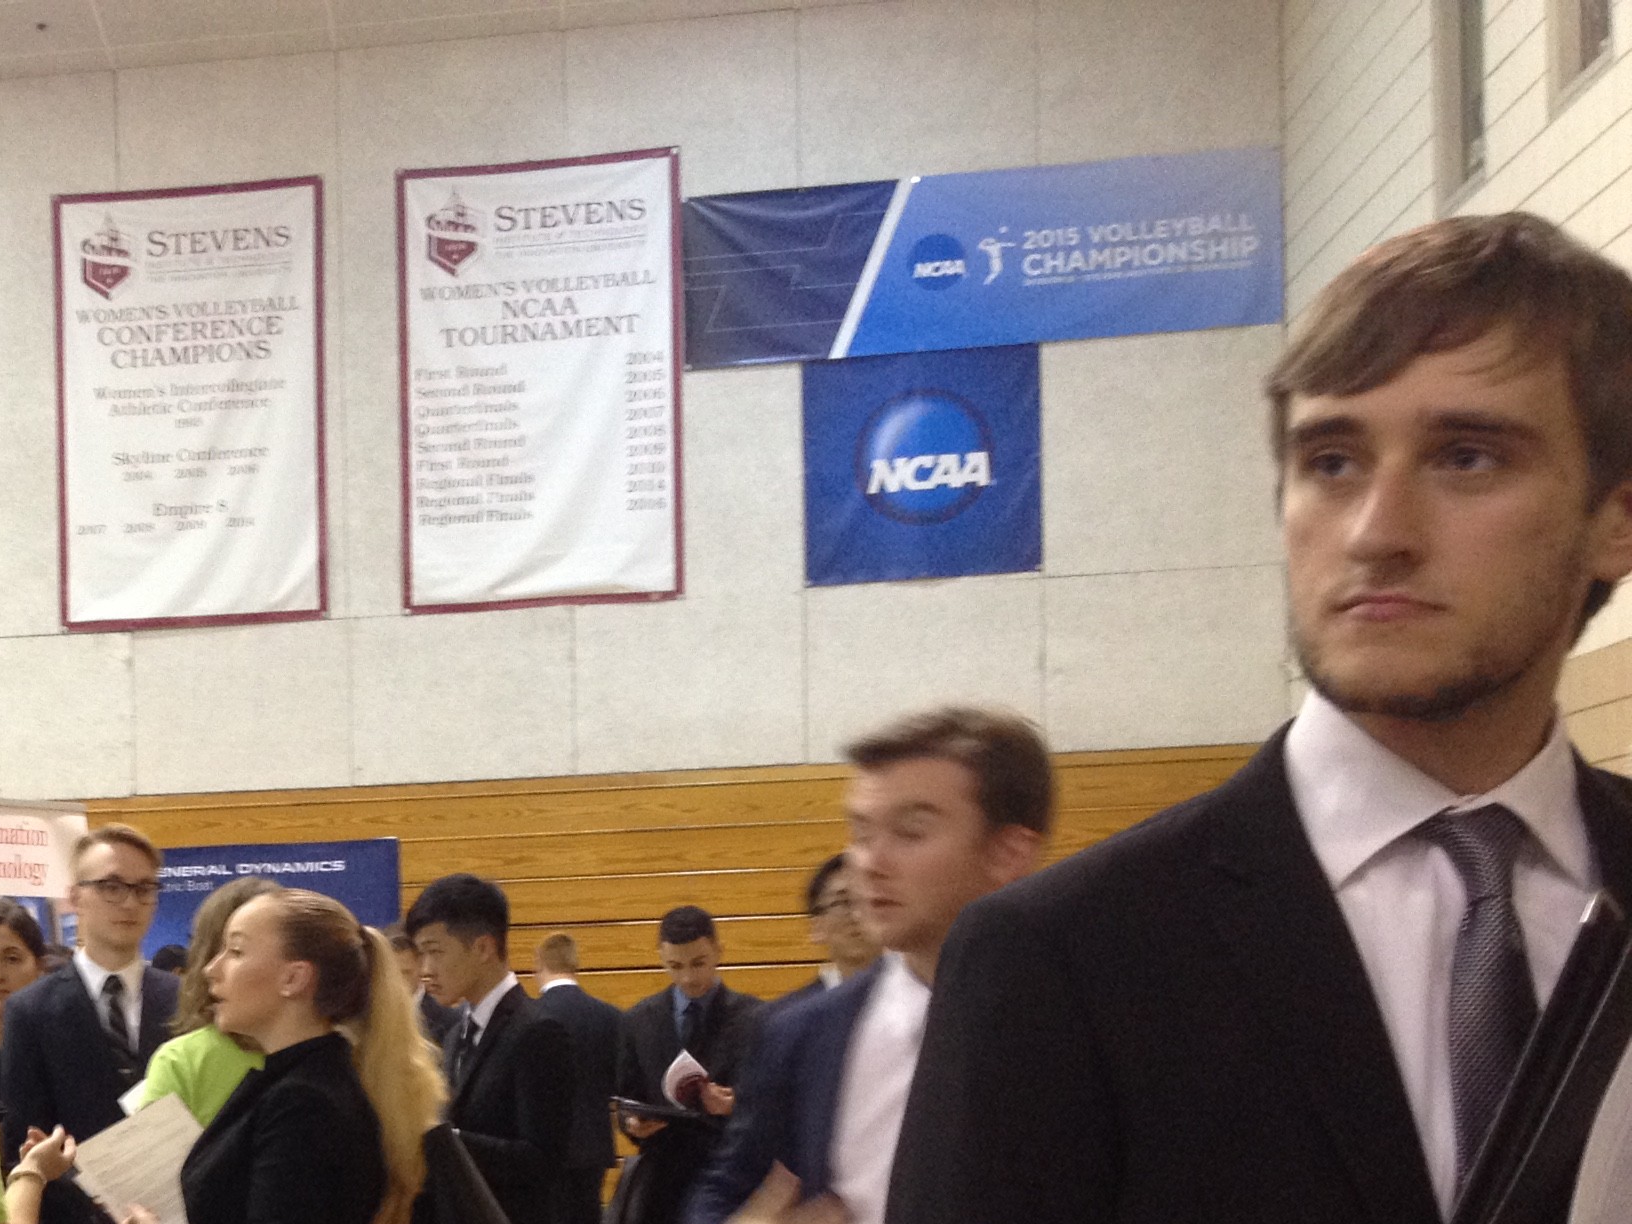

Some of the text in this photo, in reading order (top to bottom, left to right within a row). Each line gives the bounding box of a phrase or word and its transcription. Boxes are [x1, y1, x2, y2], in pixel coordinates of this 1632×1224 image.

[494, 199, 648, 232] STEVENS
[147, 225, 291, 257] STEVENS
[1023, 214, 1256, 249] 2015 VOLLEYBALL
[913, 259, 965, 278] NCAA
[1021, 235, 1260, 277] CHAMPIONSHIP
[420, 270, 657, 301] WOMEN'S VOLLEYBALL
[76, 296, 300, 324] WOMEN'S VOLLEYBALL
[500, 297, 579, 319] NCAA
[97, 316, 284, 346] CONFERENCE
[439, 313, 641, 348] TOURNAMENT
[111, 340, 273, 369] CHAMPIONS
[866, 451, 992, 495] NCAA
[156, 860, 347, 878] ENERAL DYNAMICS
